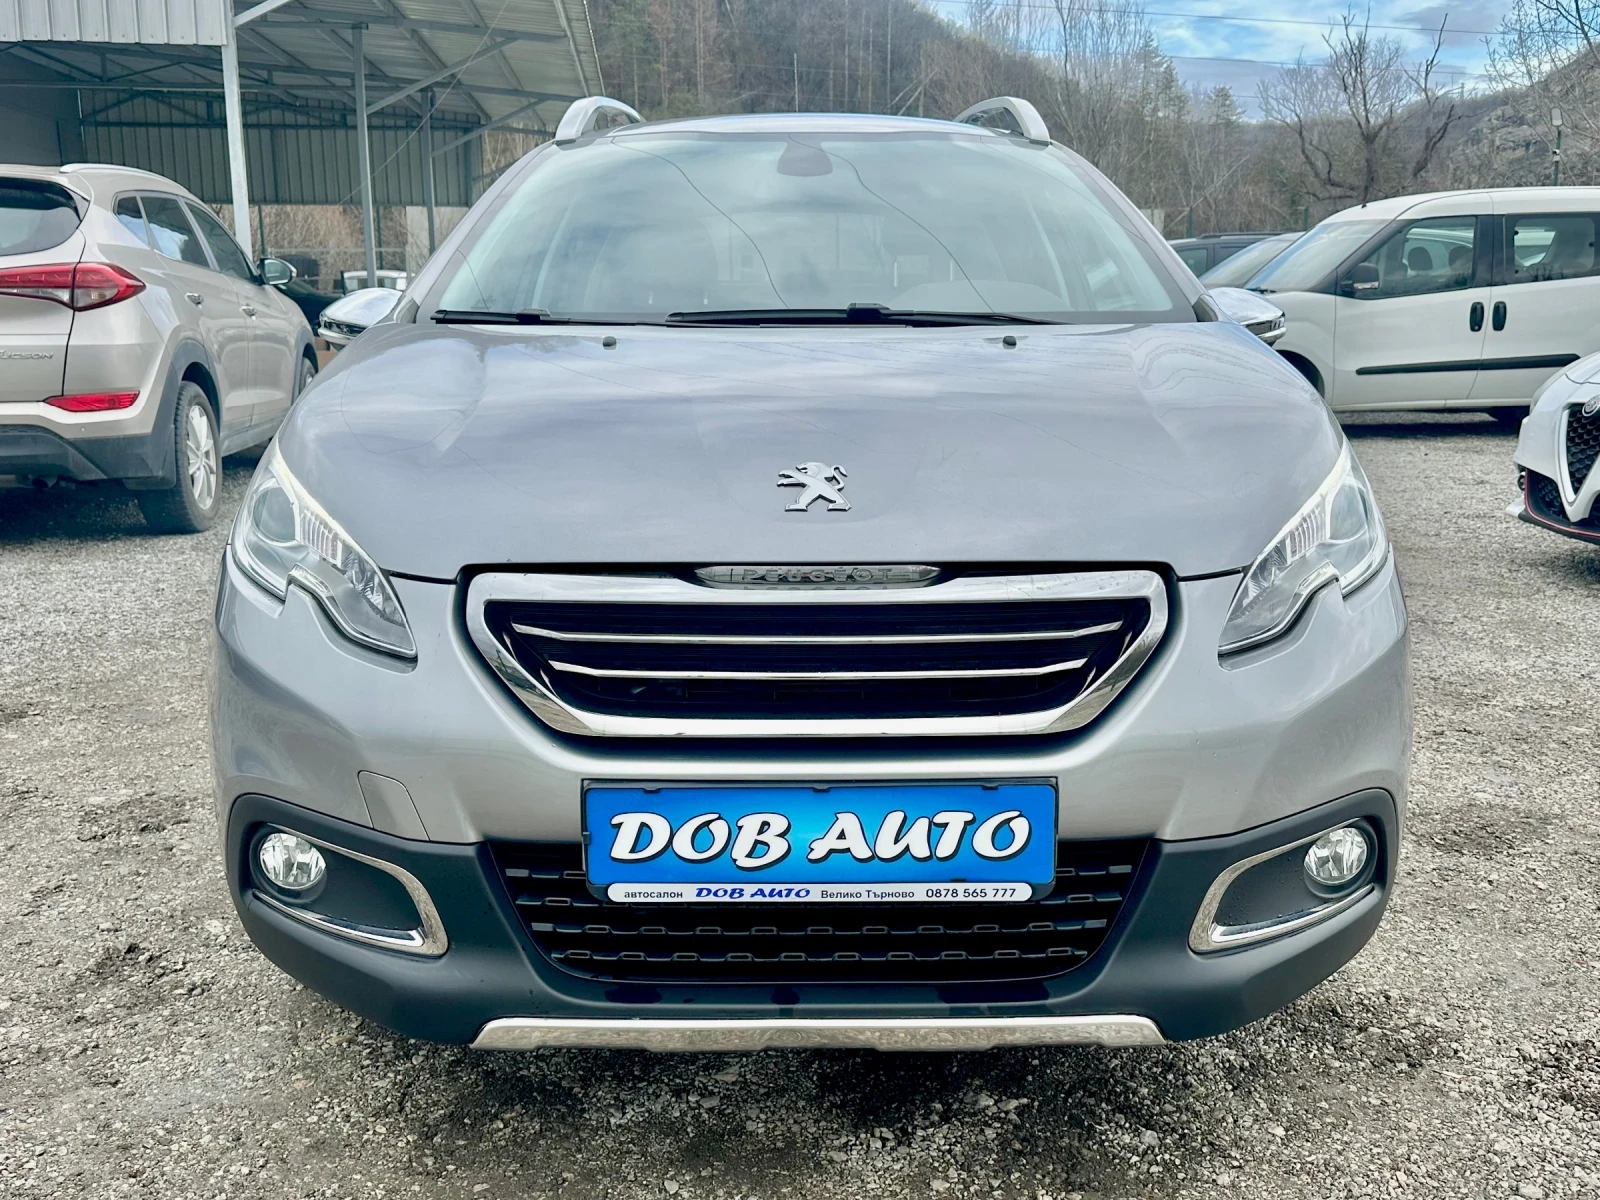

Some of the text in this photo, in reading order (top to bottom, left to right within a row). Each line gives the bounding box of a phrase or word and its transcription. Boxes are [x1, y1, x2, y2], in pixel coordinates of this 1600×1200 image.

[743, 568, 892, 582] PEUGEOT
[610, 810, 1032, 871] DOB AUTO
[624, 890, 683, 898] автосалон
[695, 887, 811, 899] DOB AUTO
[820, 888, 1017, 900] Велико Търново 0878 565 777
